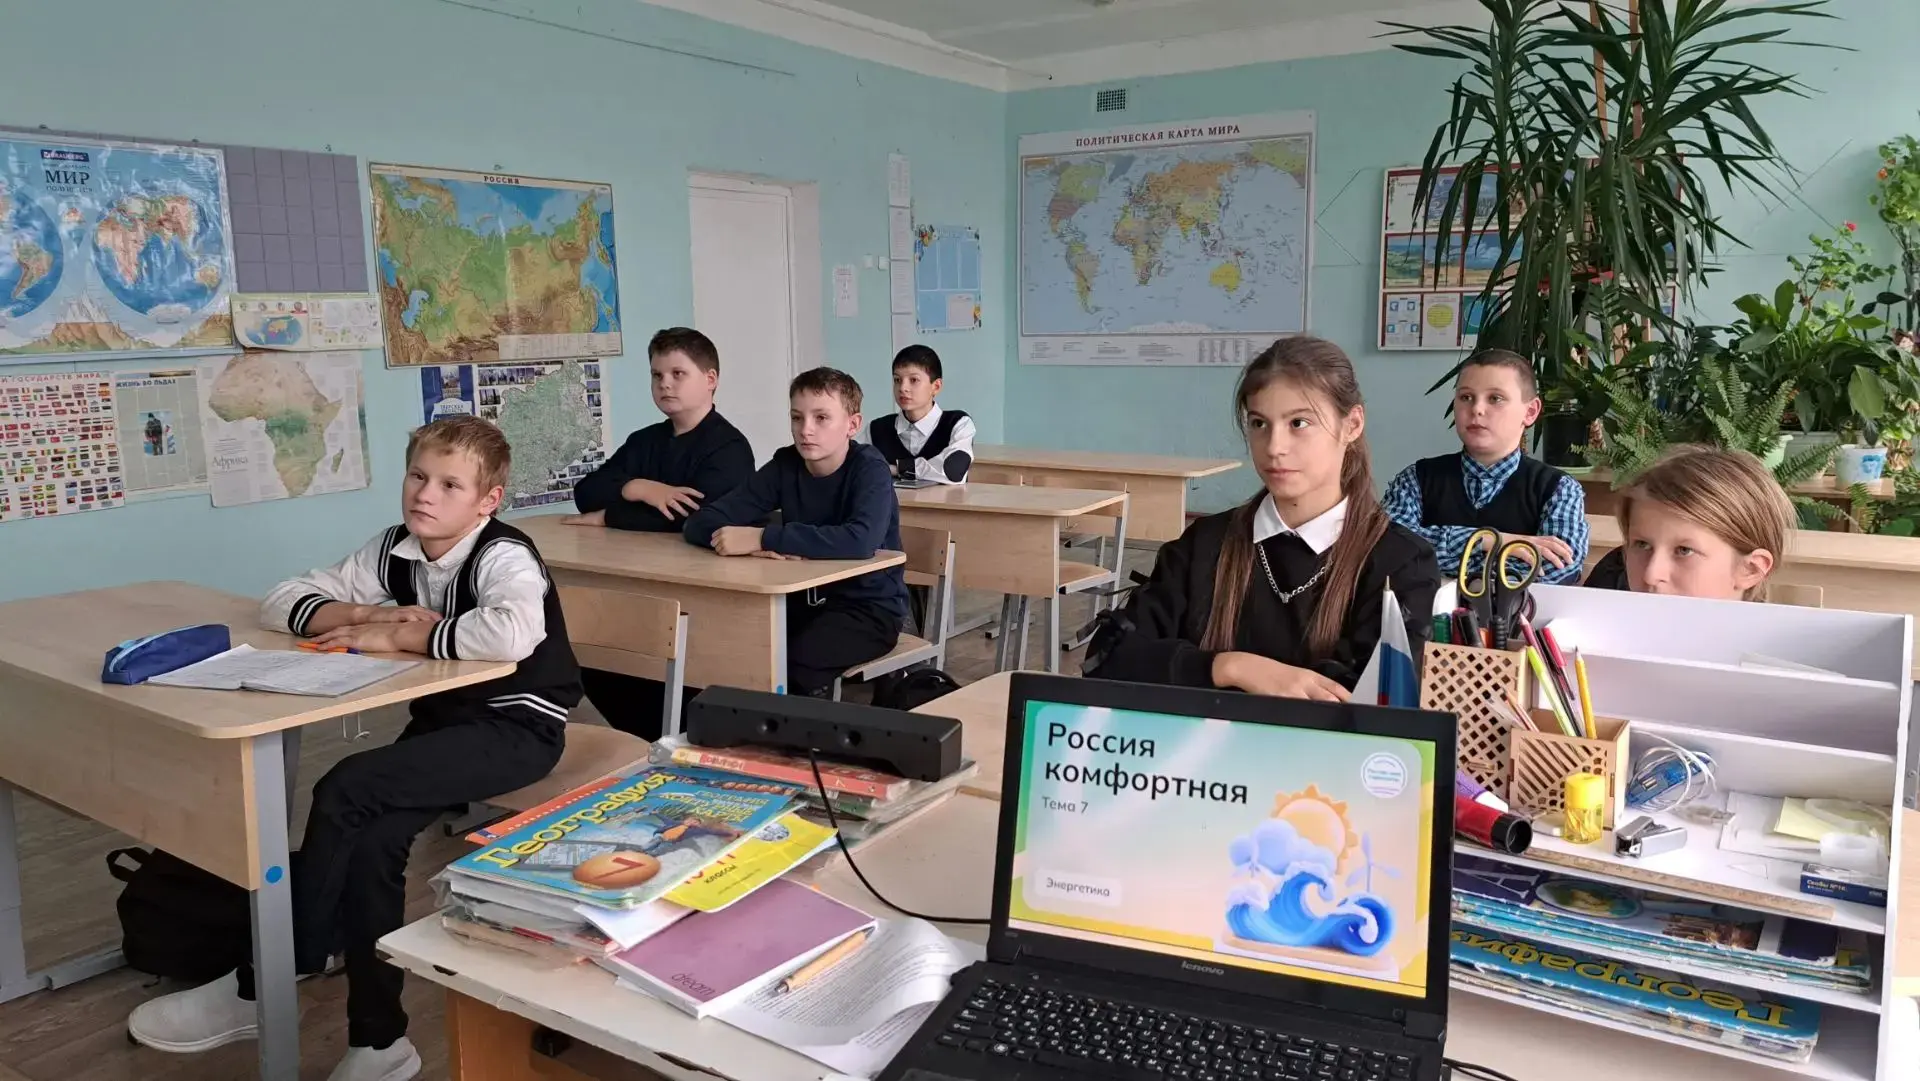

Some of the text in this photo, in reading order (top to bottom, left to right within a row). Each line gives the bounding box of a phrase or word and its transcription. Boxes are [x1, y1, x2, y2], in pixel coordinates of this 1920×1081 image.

[1075, 124, 1241, 147] ПОЛИТИЧЕСКАЯ КАРТА МИРА
[45, 170, 90, 185] МИР
[483, 175, 520, 185] РОССИЯ
[211, 455, 249, 472] Африка
[1048, 721, 1156, 758] Россия
[1044, 761, 1249, 805] комфортная
[1041, 796, 1090, 814] Тема 7
[473, 771, 678, 869] География
[1045, 877, 1111, 897] Энергетика
[1181, 960, 1225, 976] lenovo
[671, 972, 716, 997] dream
